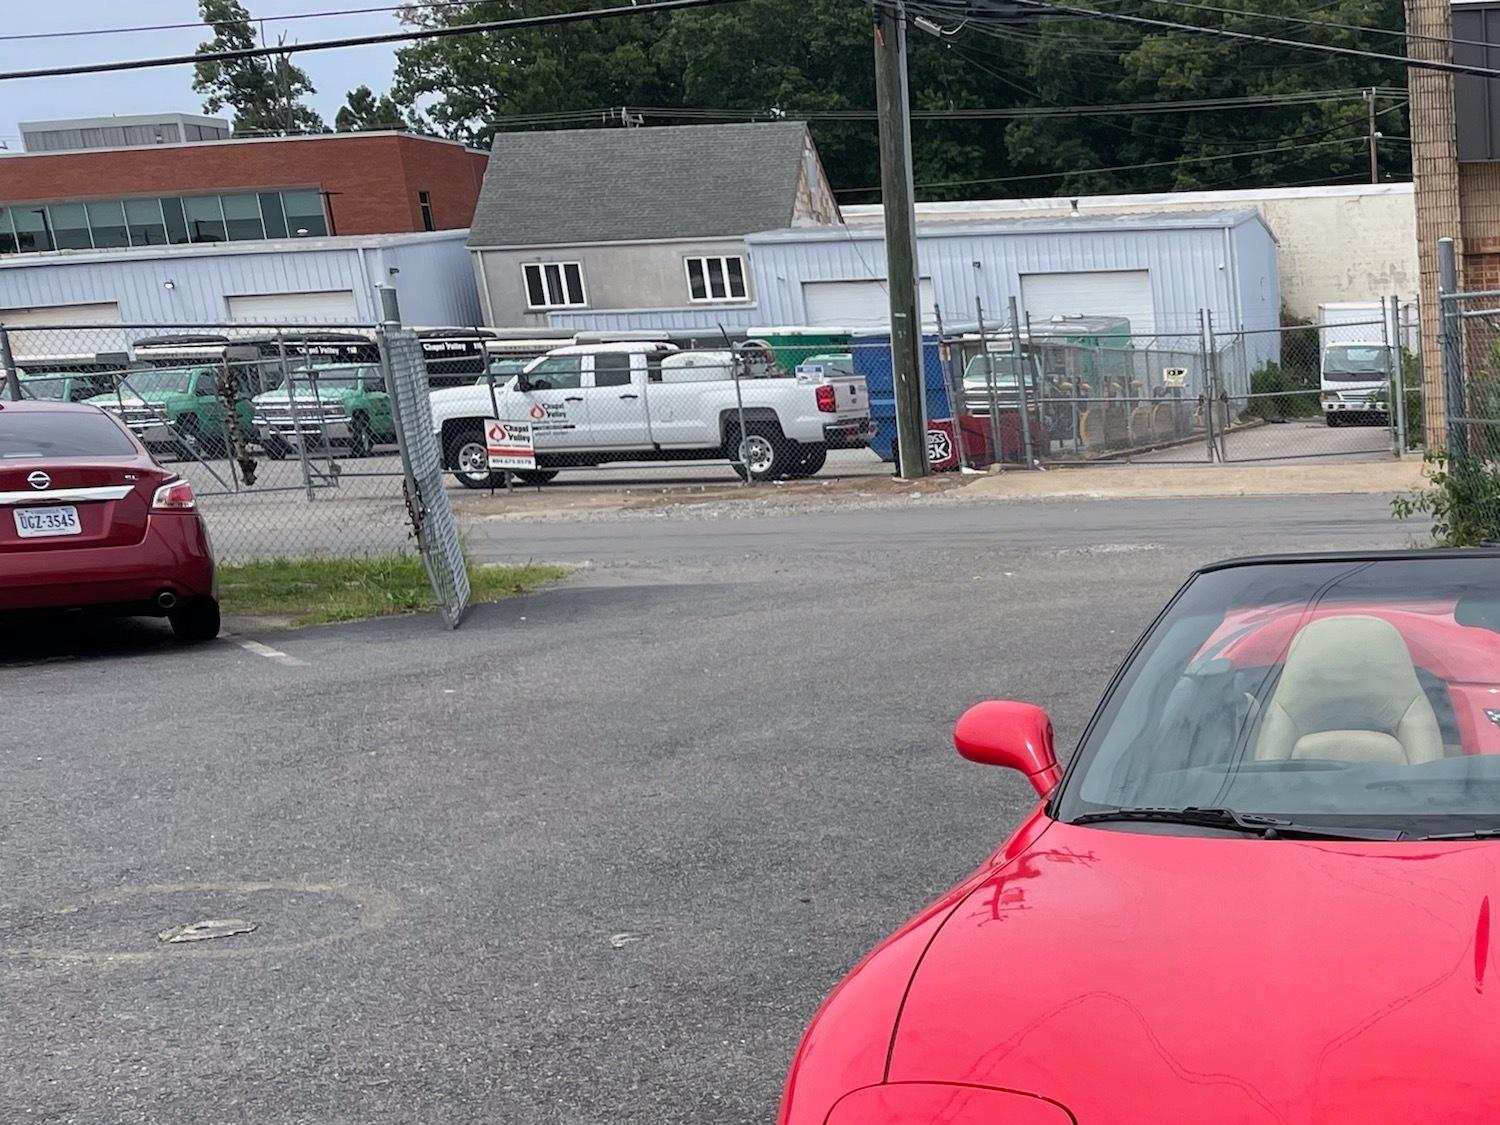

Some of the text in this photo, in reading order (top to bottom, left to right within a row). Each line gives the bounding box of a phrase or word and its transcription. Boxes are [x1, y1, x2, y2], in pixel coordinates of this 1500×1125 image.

[296, 346, 318, 354] Chpel
[503, 424, 528, 433] Chapel
[508, 432, 531, 443] Valley
[20, 514, 75, 529] UGZ-3545
